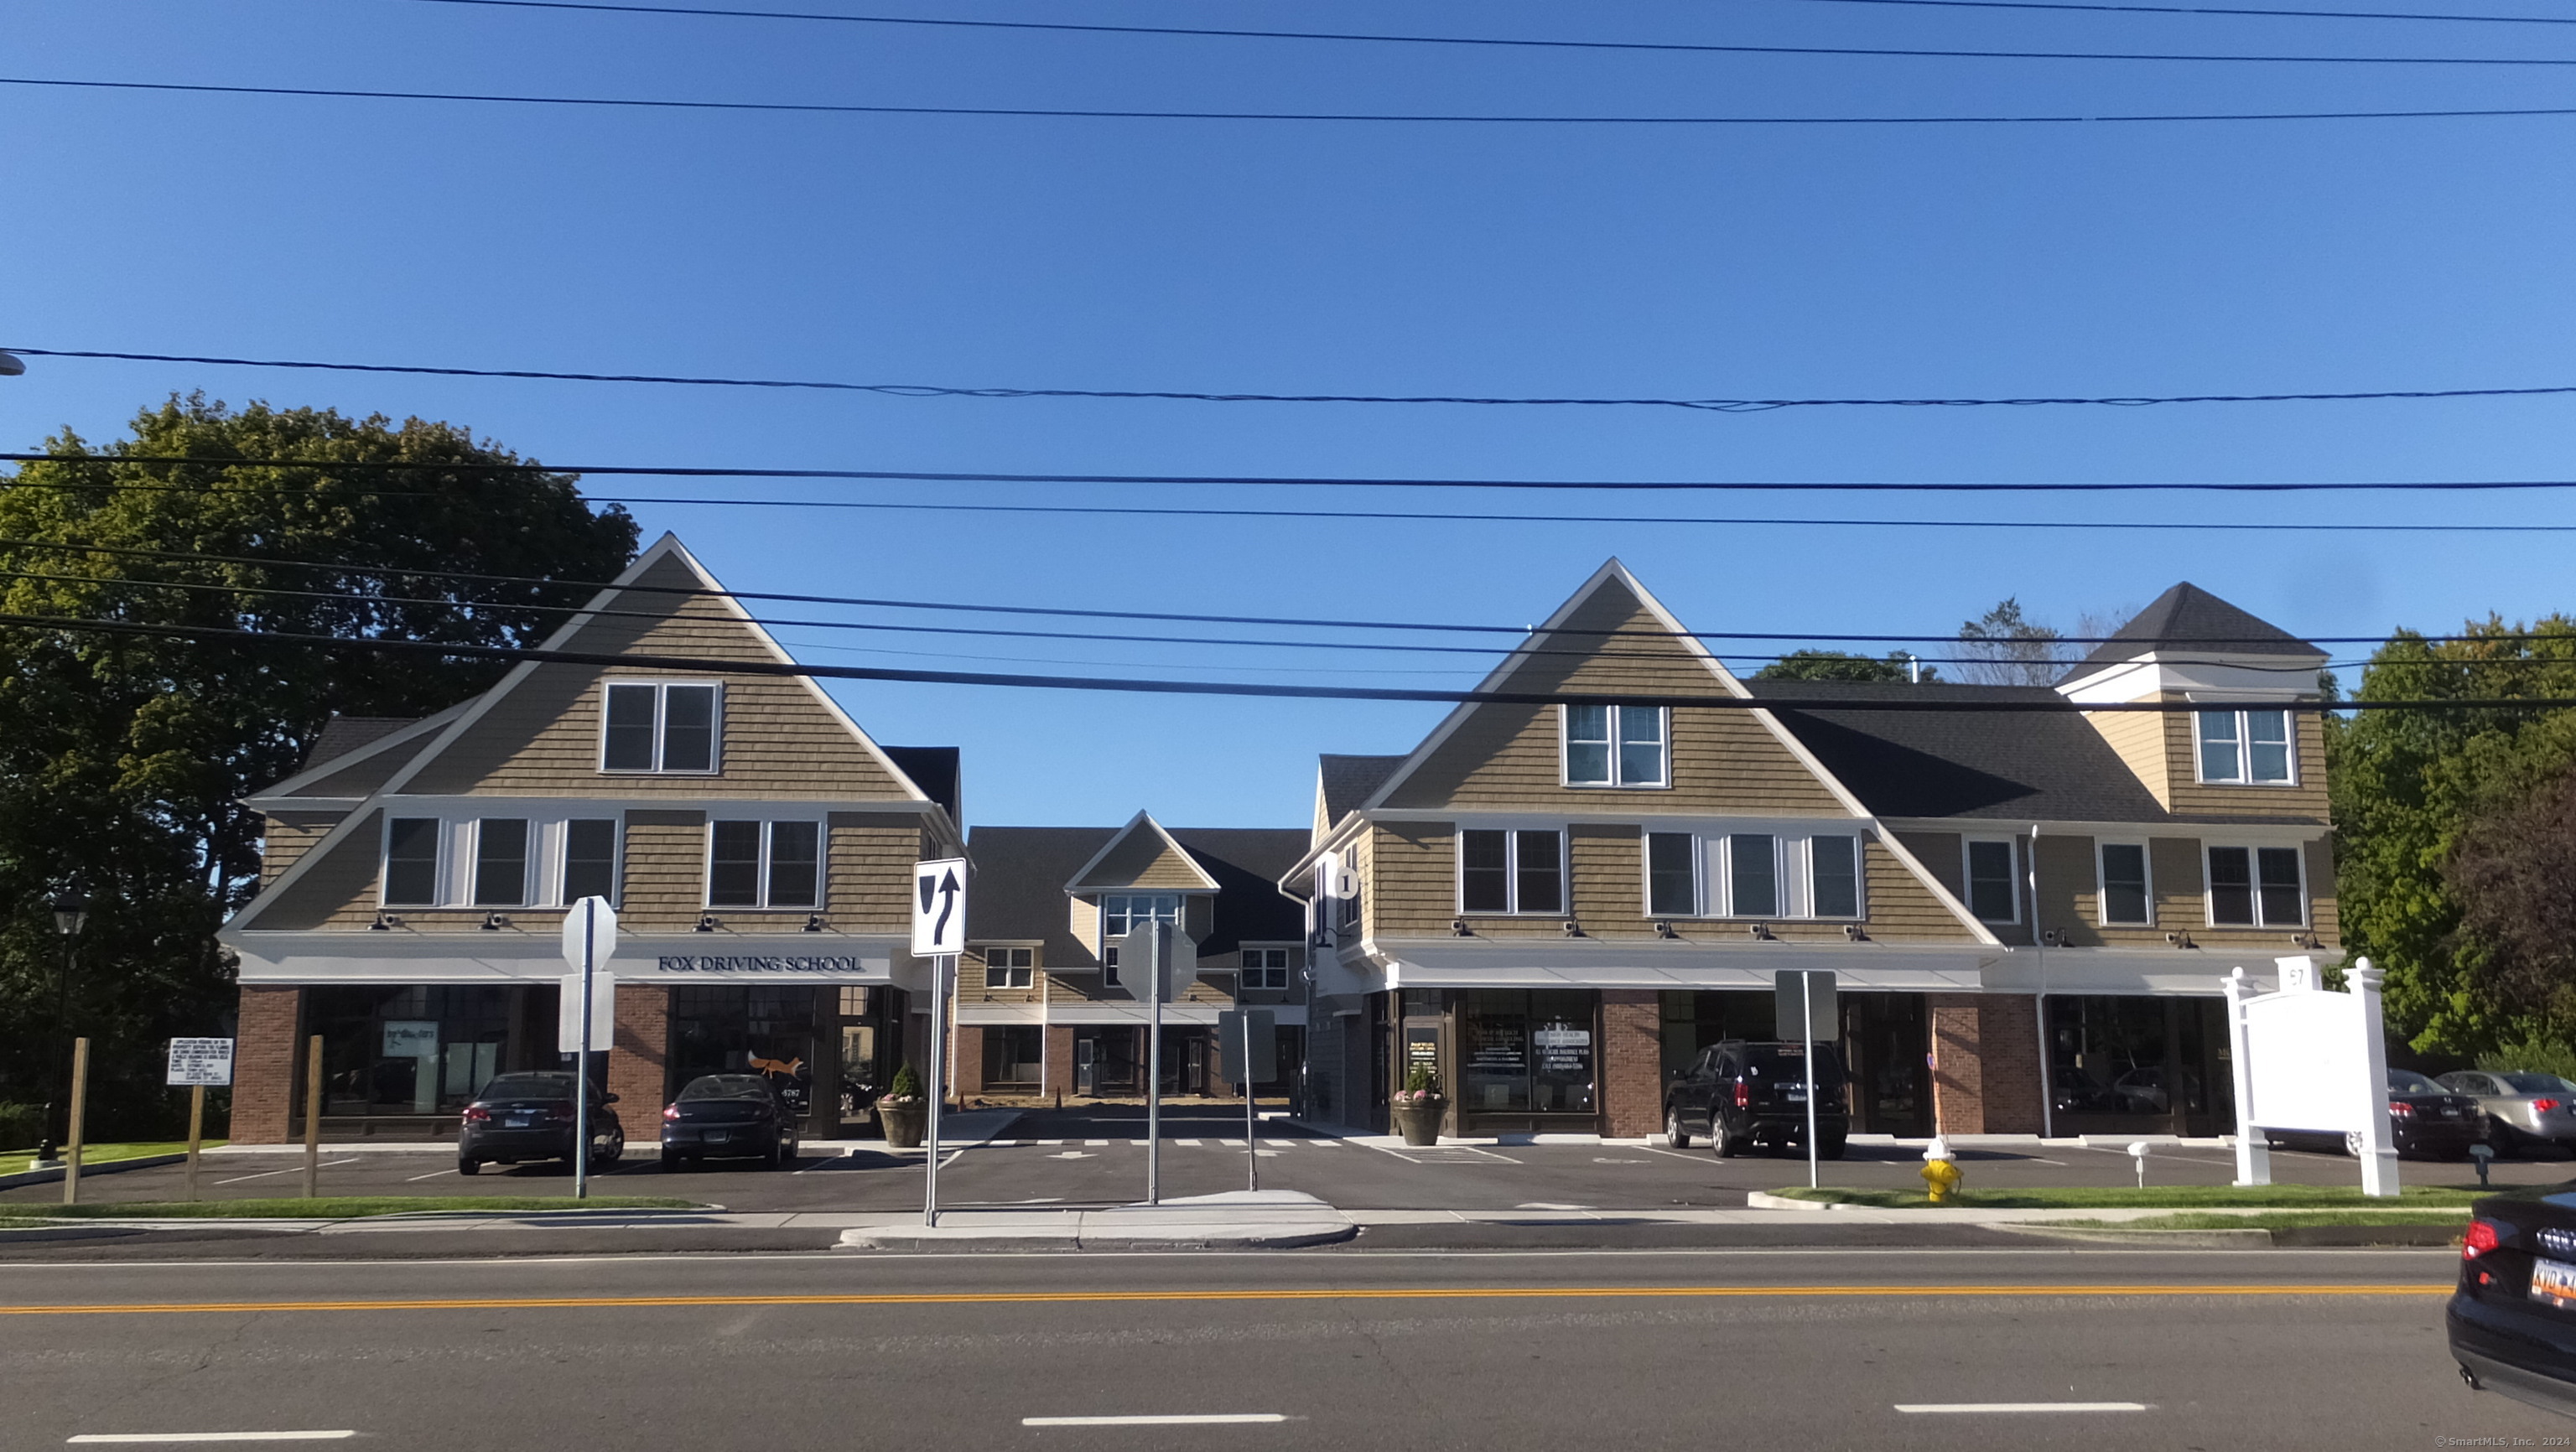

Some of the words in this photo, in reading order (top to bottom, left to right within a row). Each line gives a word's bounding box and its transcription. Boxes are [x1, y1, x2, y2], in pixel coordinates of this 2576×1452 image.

[1342, 874, 1349, 892] 1
[658, 956, 695, 971] FOX
[700, 956, 780, 971] DRIVING
[785, 956, 862, 971] SCHOOL
